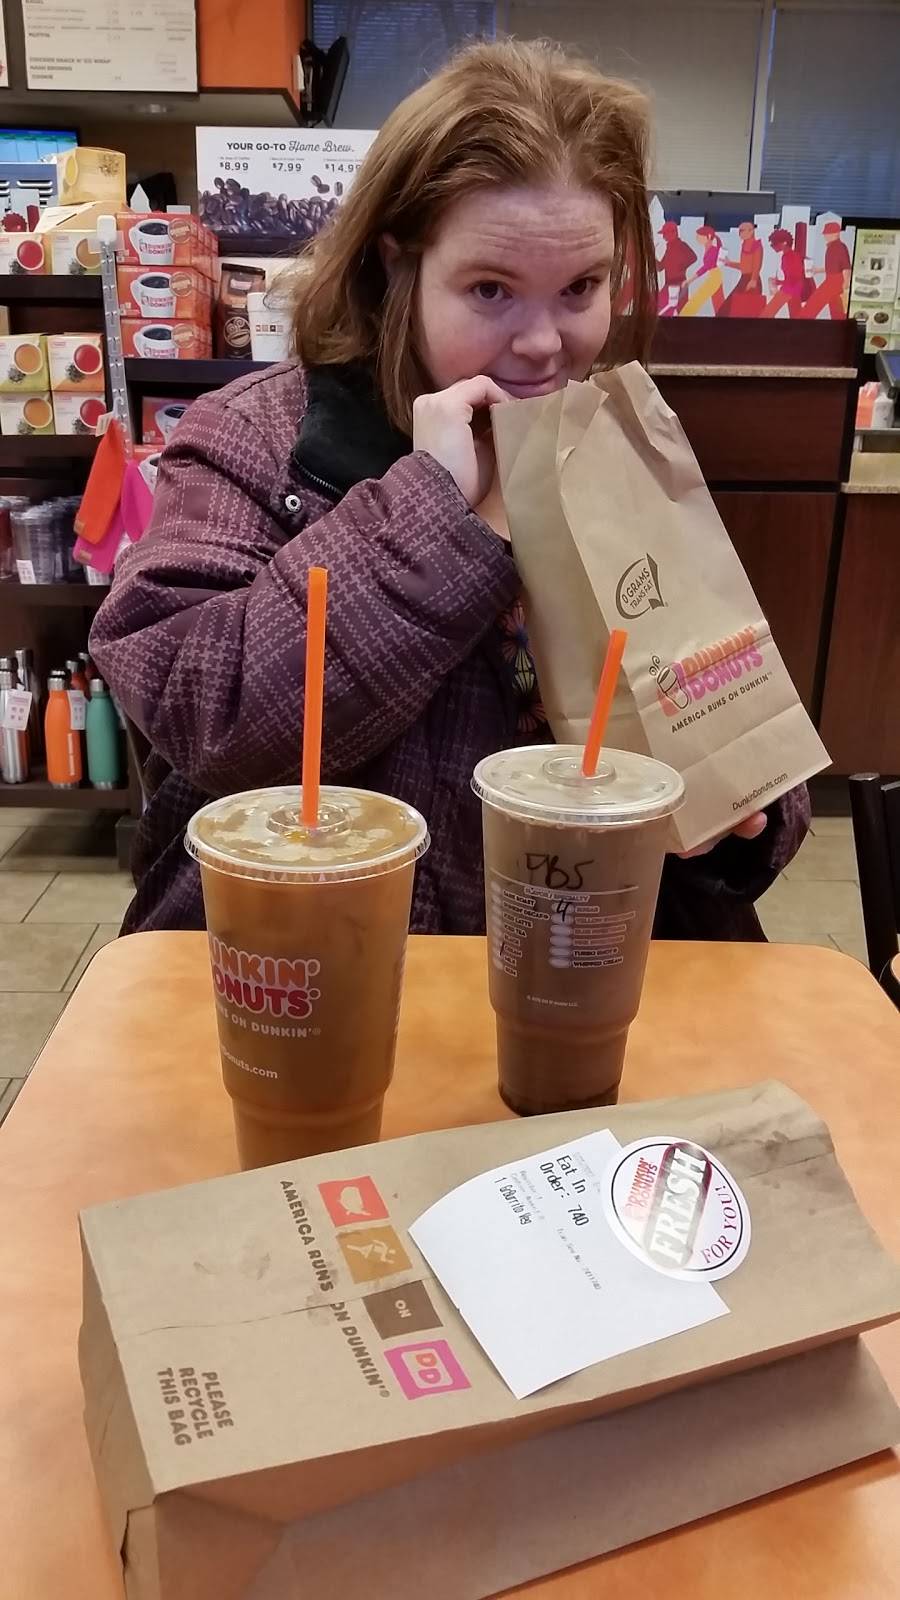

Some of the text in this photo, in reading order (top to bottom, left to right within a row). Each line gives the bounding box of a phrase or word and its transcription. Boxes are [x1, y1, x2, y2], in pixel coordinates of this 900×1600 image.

[227, 142, 253, 151] YOUR
[256, 142, 286, 151] GO-TO
[288, 140, 320, 153] Home
[219, 162, 249, 171] $8.99
[272, 162, 302, 172] $7.99
[626, 567, 650, 598] GRAMS
[630, 579, 653, 610] TRANS FAT
[689, 643, 764, 700] DONUTS
[671, 709, 706, 734] AMERICA
[708, 697, 726, 714] RUNS
[728, 691, 739, 701] ON
[732, 772, 788, 811] DunkinDonuts.com
[212, 964, 313, 1019] ONUTS
[231, 1013, 247, 1028] ON
[540, 1162, 570, 1198] Order:
[568, 1204, 590, 1226] 740
[556, 1155, 586, 1194] Eat In
[519, 1212, 532, 1225] Veg
[649, 1147, 707, 1263] FRESH
[702, 1185, 737, 1264] FOR YOU!
[280, 1180, 316, 1246] AMERICA
[307, 1249, 335, 1292] RUNS
[341, 1326, 387, 1389] DUNKIN'
[395, 1299, 412, 1319] ON
[415, 1352, 442, 1385] DD
[157, 1367, 193, 1447] THIS BAG
[178, 1367, 215, 1440] RECYCLE
[201, 1371, 235, 1429] PLEASE
